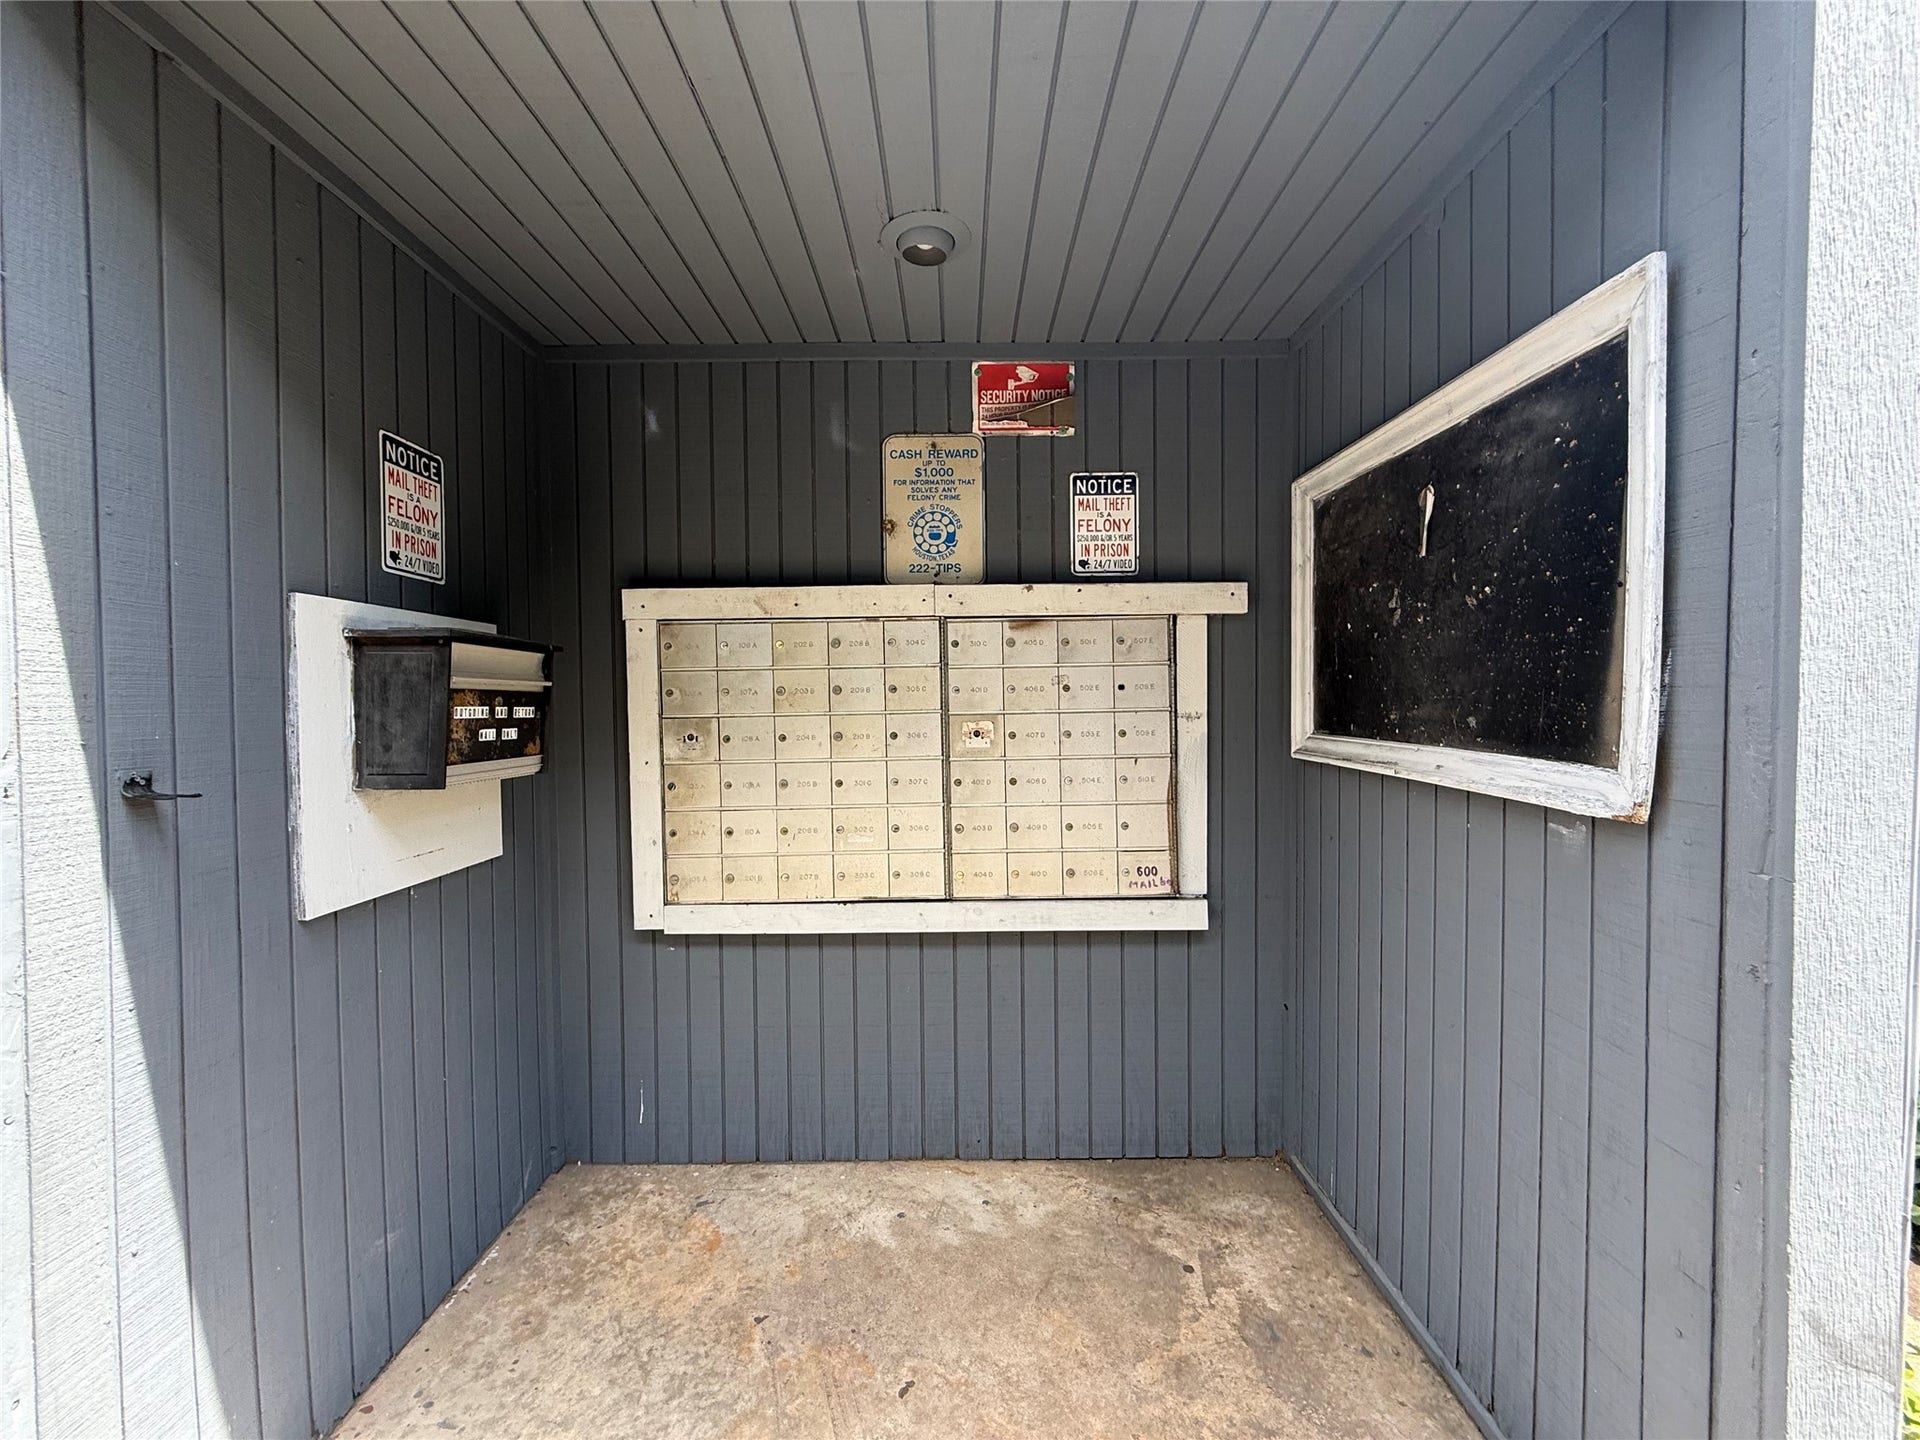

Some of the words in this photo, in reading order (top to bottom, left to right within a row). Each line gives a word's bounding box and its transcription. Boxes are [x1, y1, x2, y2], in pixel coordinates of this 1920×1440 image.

[981, 390, 1030, 404] SECURITY
[1031, 388, 1068, 401] NOTICE
[385, 440, 438, 481] NOTICE
[890, 449, 922, 459] CASH
[928, 449, 978, 459] REWARD
[915, 467, 954, 478] $1,000
[388, 466, 410, 491] MAIL
[413, 477, 437, 502] THEFT
[1076, 479, 1133, 494] NOTICE
[407, 493, 414, 501] IS
[416, 497, 422, 505] A
[1078, 498, 1100, 511] MAIL
[1104, 497, 1131, 511] THEFT
[388, 495, 438, 528] FELONY
[907, 506, 926, 527] CRIME
[930, 504, 962, 529] STOPPERS
[1078, 518, 1131, 532] FELONY
[427, 528, 440, 541] YEARS
[392, 532, 401, 549] IN
[405, 535, 437, 559] PRISON
[1081, 544, 1090, 557] IN
[1094, 543, 1129, 557] PRISON
[938, 548, 955, 560] TEXAS
[404, 555, 421, 570] 24/7
[422, 560, 440, 575] VIDEO
[909, 563, 962, 574] 222-TIPS
[1094, 559, 1111, 569] 24/7
[1113, 559, 1133, 569] VIDEO
[454, 707, 489, 718] OUTGOING
[496, 707, 507, 718] AND
[479, 729, 496, 740] MAIL
[1137, 866, 1158, 877] 600
[1129, 879, 1158, 888] MAIL
